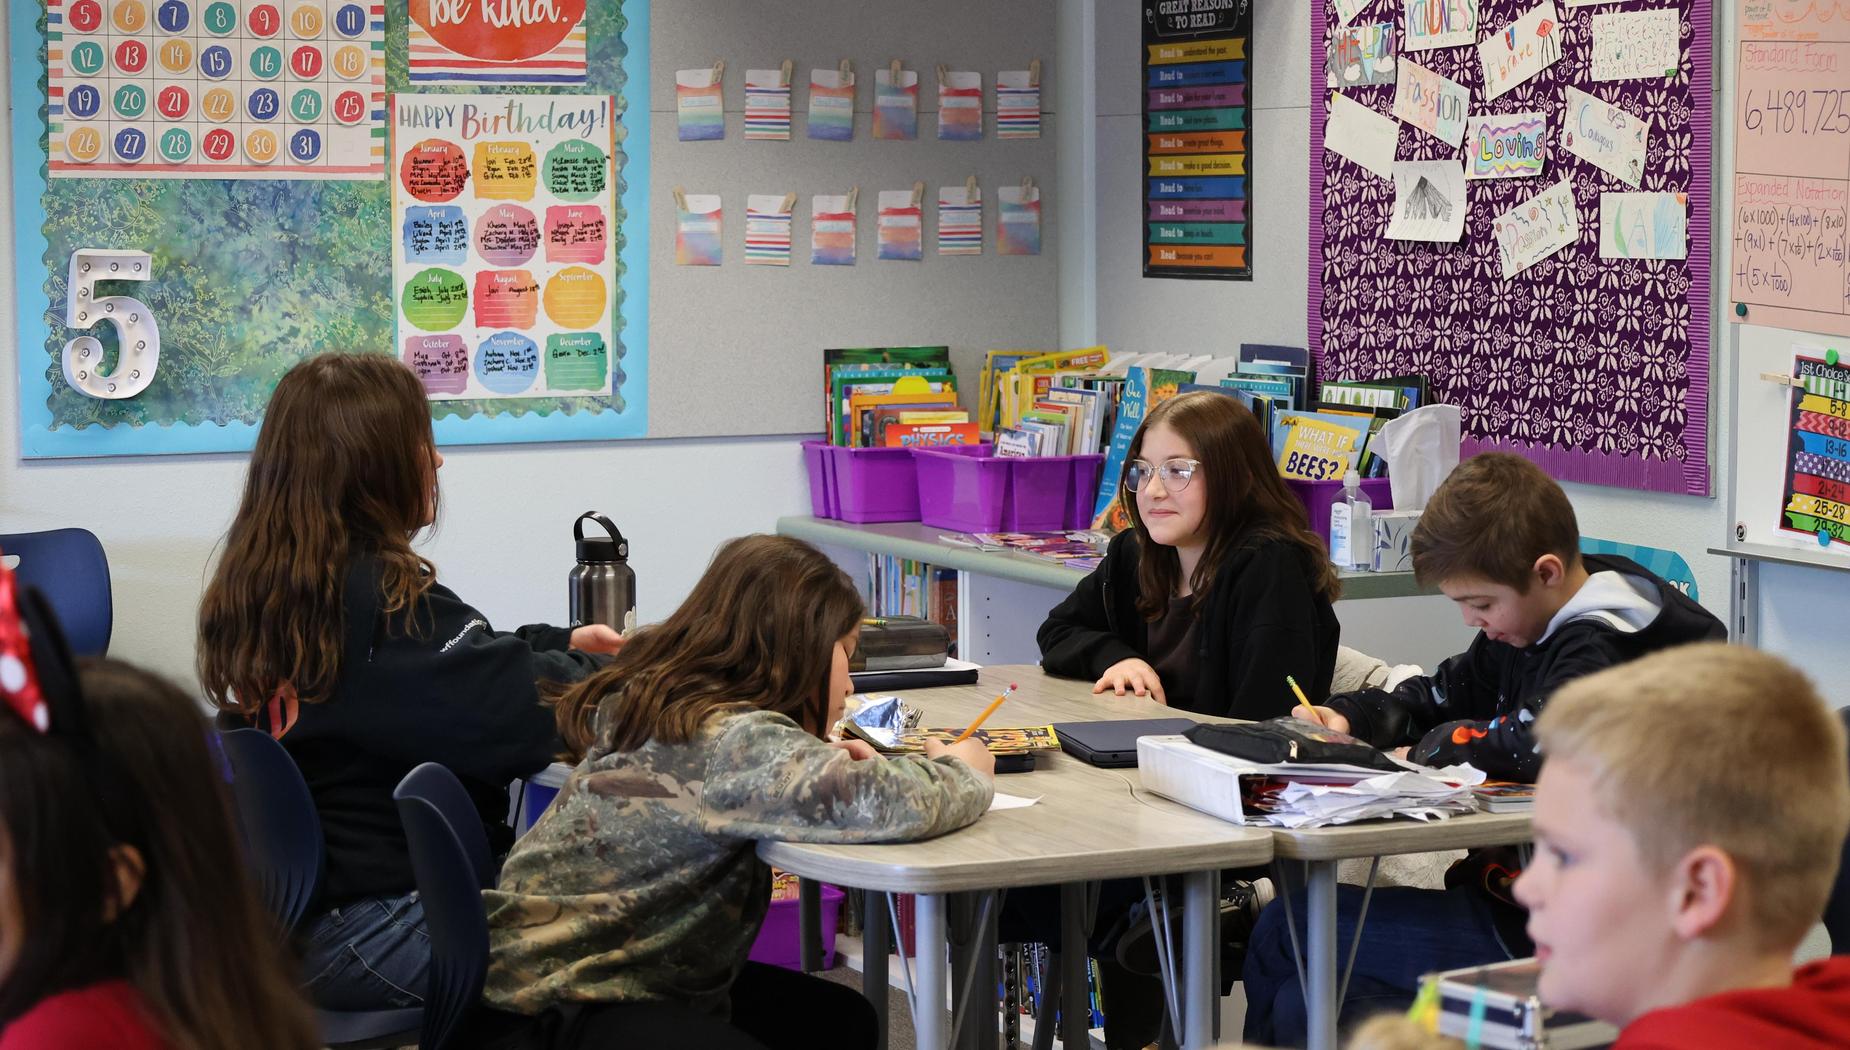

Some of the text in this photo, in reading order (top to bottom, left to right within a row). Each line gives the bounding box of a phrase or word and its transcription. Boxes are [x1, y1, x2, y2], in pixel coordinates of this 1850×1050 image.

[81, 4, 356, 30] 5 6 7 8 9 10 11
[482, 0, 568, 28] kind.
[1159, 0, 1189, 14] GREAT
[1175, 13, 1216, 29] TO READ
[1408, 0, 1475, 37] KINDNESS
[80, 47, 357, 72] 12 13 14 15 16 17 18
[1746, 42, 1838, 69] Standard Form
[77, 90, 360, 116] 19 20 21 22 23 24 25
[1406, 71, 1461, 123] Passion
[400, 99, 606, 141] HAPPY Birthday!
[1745, 89, 1850, 136] 6,489.725
[77, 133, 312, 155] 26 27 28 29 30 31
[420, 144, 585, 156] January February March
[1480, 131, 1546, 162] Loving
[1737, 176, 1846, 202] Expanded Notation
[427, 208, 583, 220] April May June
[427, 273, 594, 286] July August September
[62, 248, 161, 400] 5
[423, 337, 592, 348] October November December
[1072, 356, 1088, 366] FREE
[1801, 362, 1814, 375] 1st
[1816, 364, 1843, 381] Choice
[1125, 379, 1142, 398] One
[1833, 382, 1846, 395] 1-4
[1121, 400, 1141, 420] Well
[1830, 401, 1847, 416] 5-8
[1298, 425, 1349, 449] WHAT IF
[1828, 419, 1847, 437] 9-12
[900, 433, 966, 447] PHYSICS
[1825, 439, 1847, 457] 13-16
[1285, 450, 1339, 480] BEES?
[1822, 458, 1847, 477] 17-20
[1818, 481, 1845, 499] 21-24
[1814, 500, 1846, 520] 25-28
